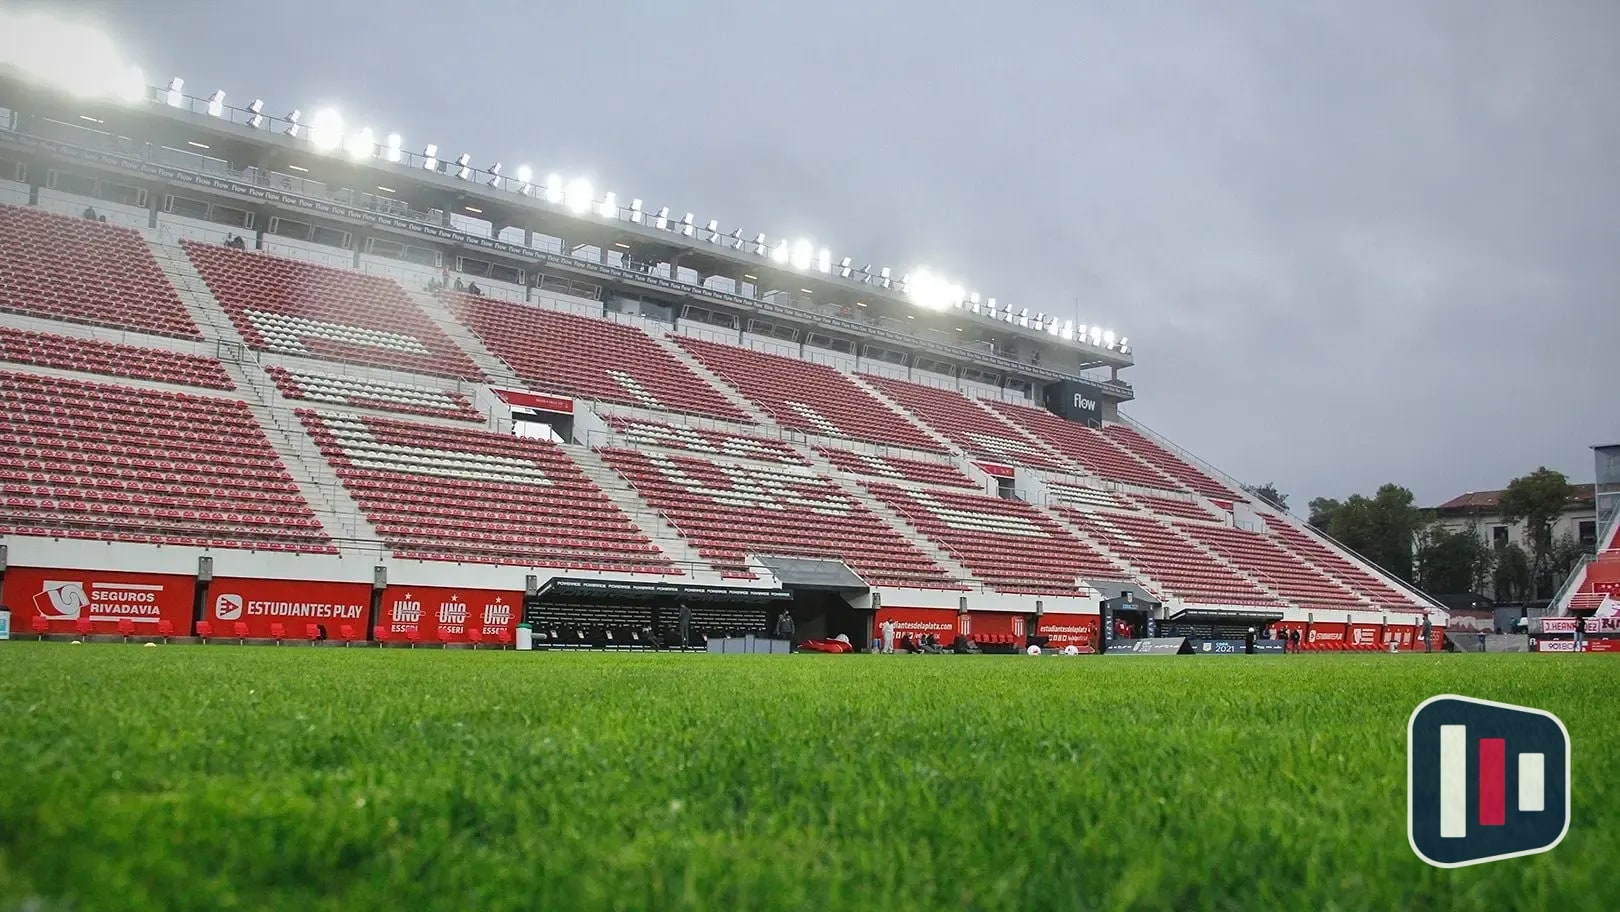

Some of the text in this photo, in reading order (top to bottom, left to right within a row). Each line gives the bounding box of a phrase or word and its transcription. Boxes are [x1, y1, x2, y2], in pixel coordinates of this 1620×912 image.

[141, 165, 157, 174] flow
[159, 169, 174, 178] flow
[177, 173, 192, 182] flow
[196, 176, 210, 185] flow
[214, 181, 229, 189] flow
[232, 184, 247, 193] flow
[249, 188, 264, 197] flow
[265, 192, 280, 200] flow
[282, 196, 296, 204] flow
[299, 199, 313, 208] flow
[315, 203, 329, 211] flow
[332, 207, 346, 216] flow
[348, 210, 361, 219] flow
[362, 213, 376, 221] flow
[378, 216, 391, 225] flow
[394, 220, 407, 228] flow
[409, 223, 422, 231] flow
[424, 226, 437, 235] flow
[439, 230, 452, 238] flow
[452, 233, 464, 241] flow
[467, 236, 478, 244] flow
[1073, 393, 1096, 411] flow
[91, 590, 155, 602] SEGUROS
[90, 603, 160, 615] RIVADAVIA
[247, 601, 363, 619] ESTUDIANTES PLAY
[392, 600, 421, 622] UNO
[439, 602, 466, 624] UNO
[483, 604, 510, 625] UNO
[482, 627, 508, 635] ESS
[879, 620, 953, 631] ediantesdelaplata.com
